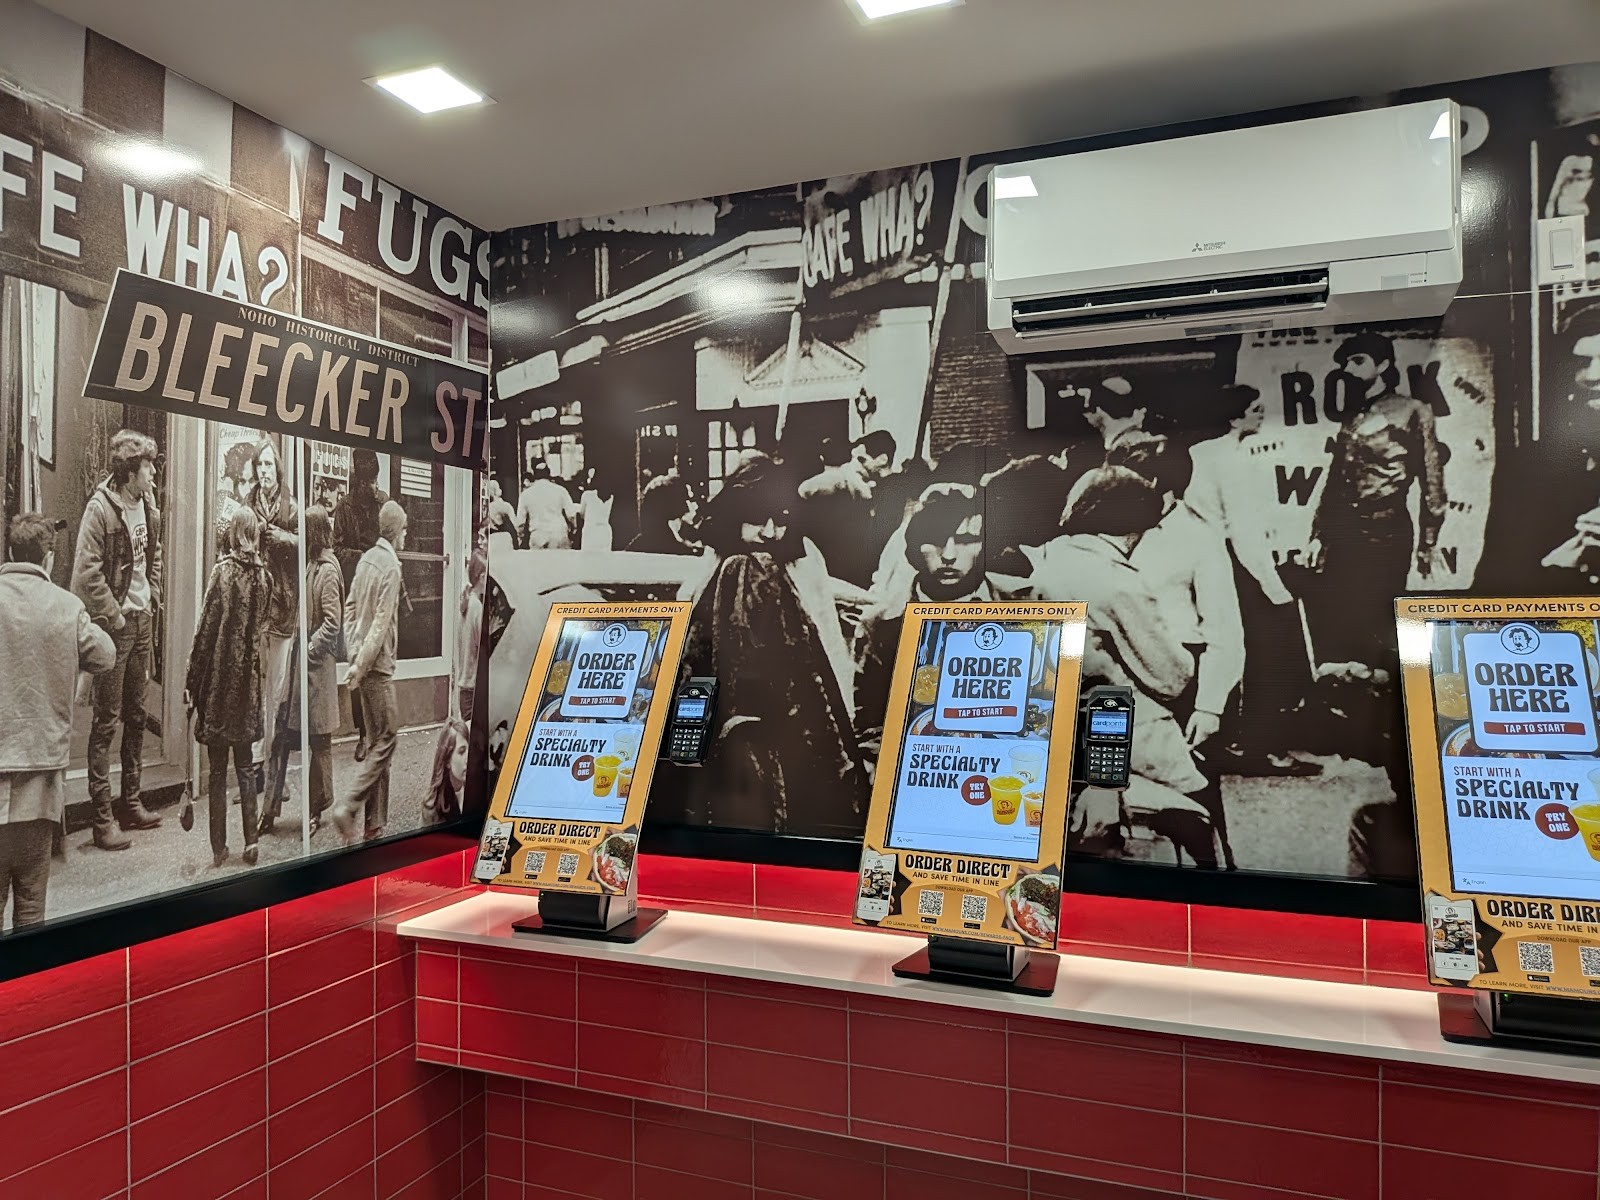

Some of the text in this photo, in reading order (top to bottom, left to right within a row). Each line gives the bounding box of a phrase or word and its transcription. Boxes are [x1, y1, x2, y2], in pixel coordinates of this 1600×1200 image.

[860, 169, 935, 264] WHA?
[122, 183, 289, 307] WHA?
[238, 307, 420, 368] NOHO HISTORICAL DISTRICT
[114, 301, 410, 444] BLEECKER
[613, 606, 658, 614] PAYMENTS
[913, 607, 1078, 615] CREDIT CARD PAYMENTS ONLY
[1408, 604, 1459, 613] CREDIT
[1462, 604, 1502, 613] CARD
[1507, 603, 1585, 613] PAYMENTS
[578, 652, 637, 671] ORDER
[948, 656, 1023, 677] ORDER
[577, 671, 626, 690] HERE
[1474, 662, 1578, 686] ORDER
[951, 678, 1012, 699] HERE
[1489, 688, 1570, 713] HERE
[958, 707, 1004, 717] TAP TO START
[539, 728, 578, 737] START WITH A
[1504, 723, 1566, 733] TAP TO START
[535, 738, 607, 753] SPECIALTY
[912, 743, 961, 753] START WITH A
[530, 752, 573, 767] DRINK
[578, 761, 591, 769] TRY
[910, 754, 1000, 773] SPECIALTY
[907, 771, 959, 789] DRINK
[1453, 765, 1522, 778] START WITH A
[969, 783, 985, 791] TRY
[969, 791, 985, 799] ONE
[1455, 778, 1579, 801] SPECIALTY
[1456, 799, 1531, 820] DRINK
[1545, 812, 1566, 822] TRY
[519, 821, 601, 839] ORDER DIRECT
[1548, 823, 1570, 832] ONE
[905, 854, 1010, 879] ORDER DIRECT
[912, 871, 1000, 887] AND SAVE TIME IN LINE
[1486, 899, 1555, 920] ORDER
[1501, 919, 1598, 934] AND SAVE TIME IN
